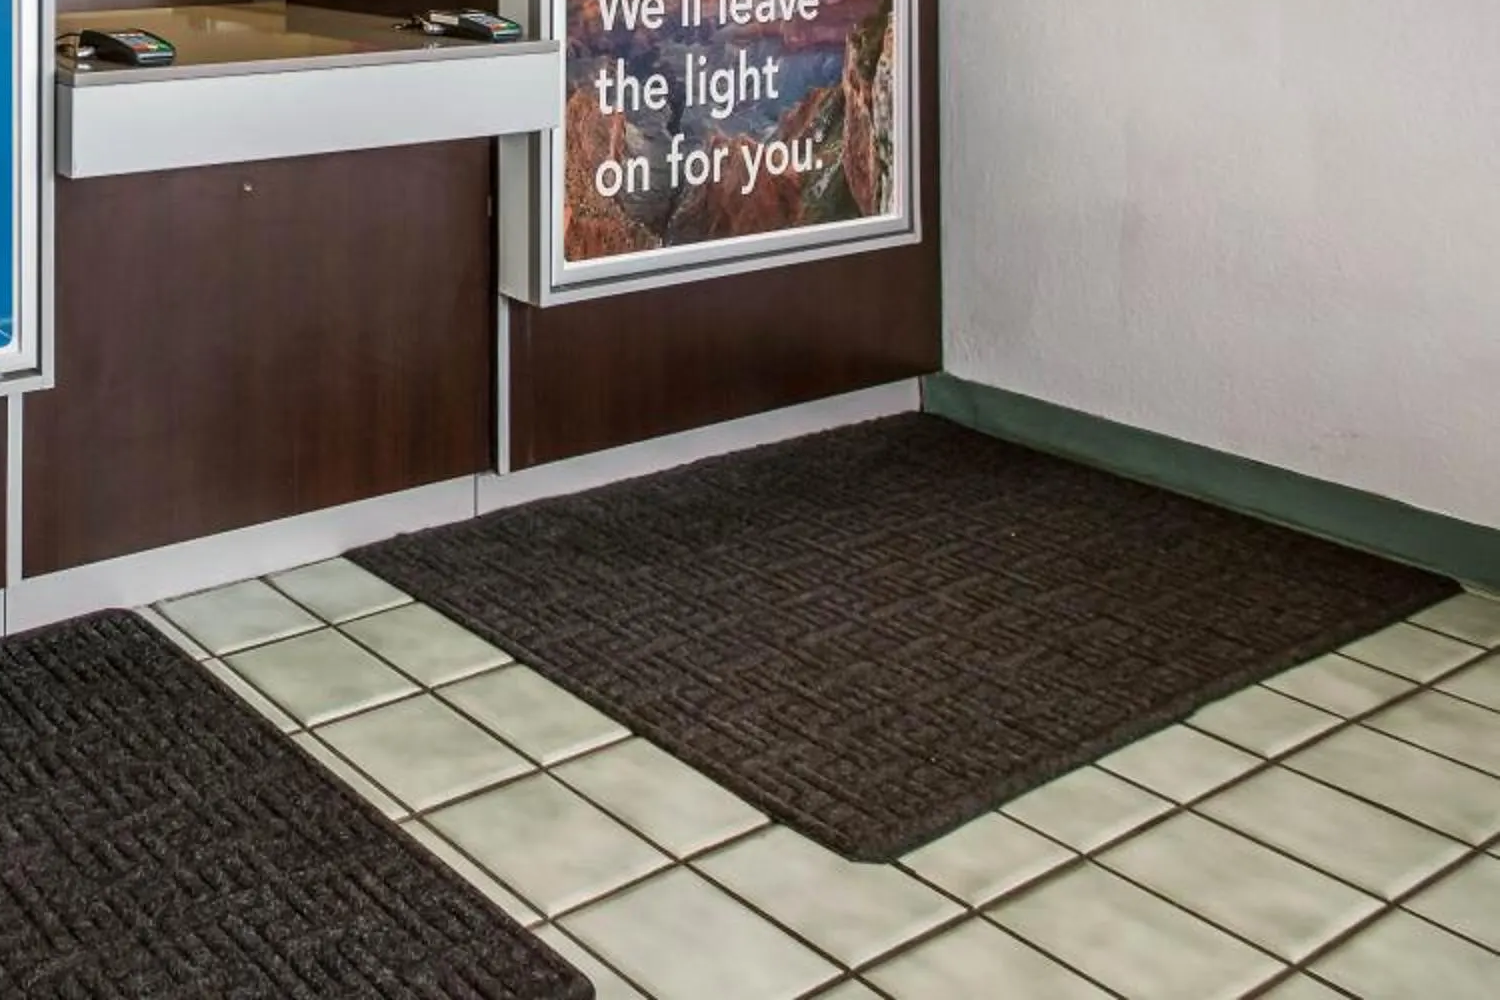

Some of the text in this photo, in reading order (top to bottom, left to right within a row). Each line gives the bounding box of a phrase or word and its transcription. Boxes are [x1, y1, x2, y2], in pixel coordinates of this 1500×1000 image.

[594, 49, 779, 119] the light
[595, 133, 823, 198] on for you.
